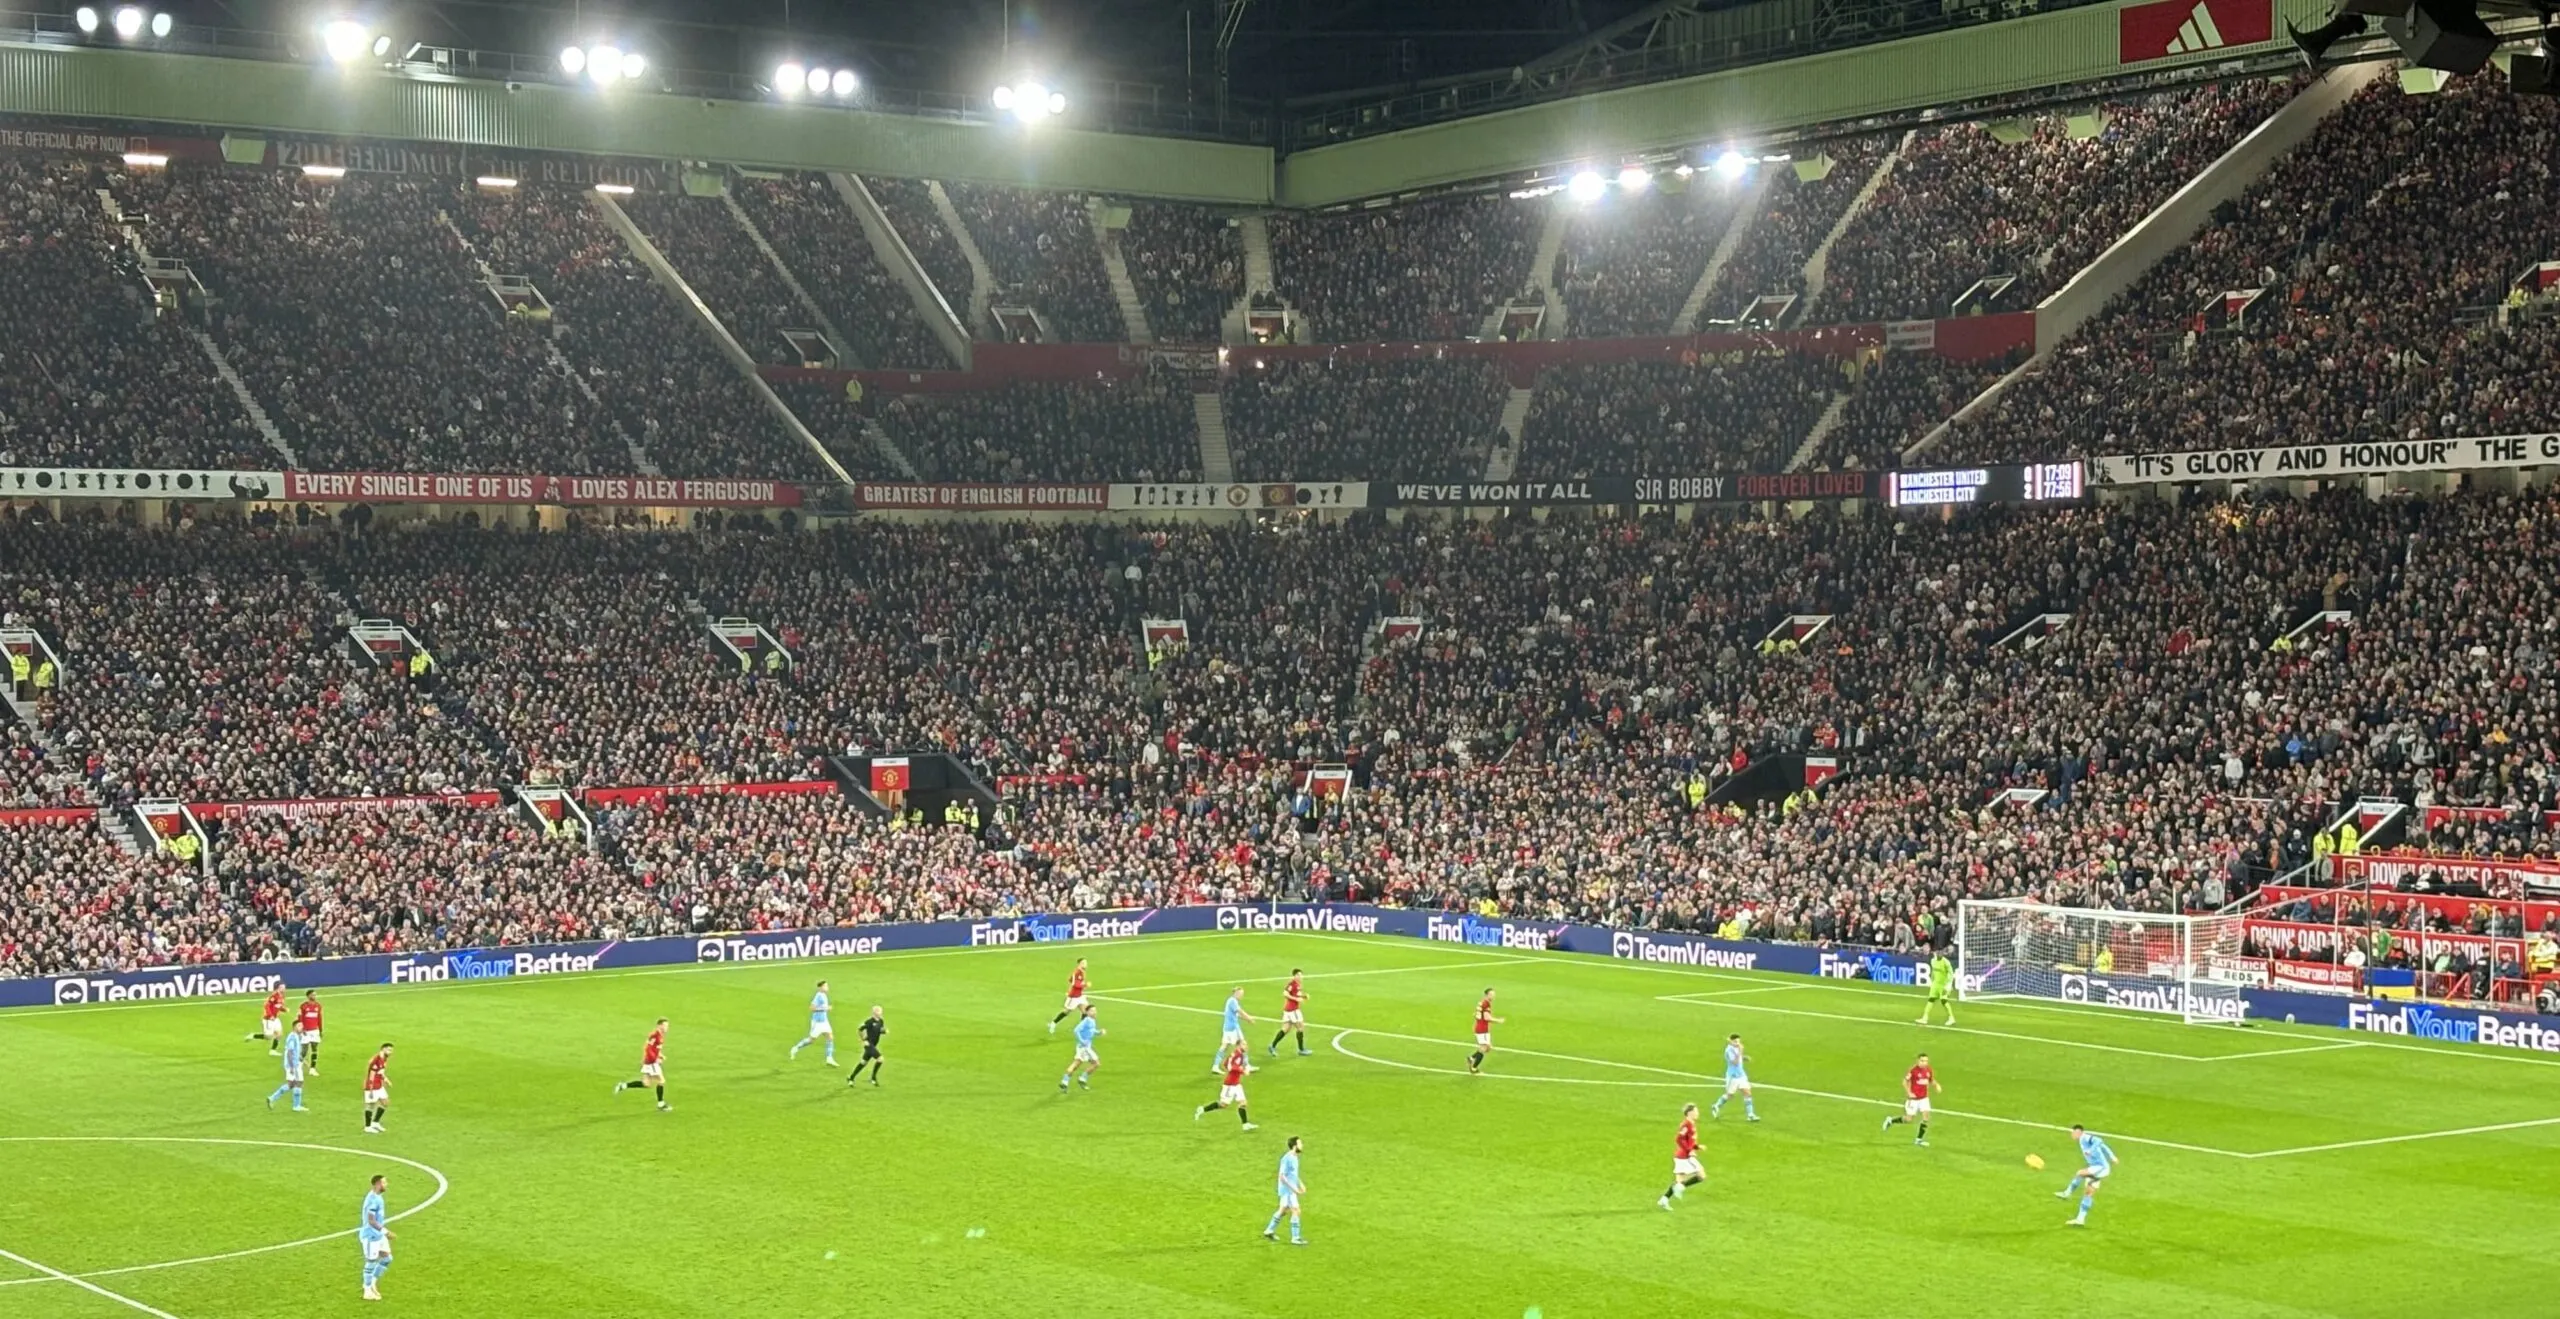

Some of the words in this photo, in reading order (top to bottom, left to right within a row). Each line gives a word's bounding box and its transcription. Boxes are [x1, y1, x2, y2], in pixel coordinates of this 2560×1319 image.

[24, 131, 74, 150] OFFICIAL
[75, 134, 98, 151] APP
[99, 135, 126, 152] NOW
[541, 159, 657, 189] RELIGION
[2186, 451, 2265, 474] GLORY
[2276, 448, 2328, 470] AND
[2340, 441, 2458, 467] HONOUR"
[2475, 438, 2527, 461] THE
[1955, 470, 1988, 485] UNITED
[2044, 464, 2072, 481] 17:09
[295, 474, 356, 495] EVERY
[361, 474, 429, 496] SINGLE
[435, 476, 473, 497] ONE
[478, 477, 502, 498] OF
[507, 477, 532, 498] US
[572, 479, 628, 499] LOVES
[634, 480, 678, 500] ALEX
[684, 480, 774, 501] FERGUSON
[863, 486, 936, 503] GREATEST
[941, 487, 957, 504] OF
[962, 487, 1023, 504] ENGLISH
[1028, 486, 1103, 504] FOOTBALL
[1397, 484, 1462, 500] WE'VE
[1469, 484, 1520, 500] WON
[1526, 483, 1547, 499] IT
[1550, 483, 1592, 499] ALL
[1635, 477, 1662, 500] SIR
[1669, 476, 1725, 499] BOBBY
[1737, 474, 1809, 497] FOREVER
[1814, 473, 1865, 495] LOVED
[1955, 487, 1976, 502] CITY
[2024, 483, 2033, 500] 2
[2044, 481, 2072, 498] 77:56
[972, 920, 1019, 946] Find
[1073, 917, 1143, 939] Better
[1240, 908, 1379, 933] TeamViewer
[1428, 916, 1462, 943] Find
[1462, 918, 1503, 946] Your
[727, 934, 882, 961] TeamViewer
[1634, 936, 1756, 970] TeamViewer
[391, 956, 449, 984] Find
[450, 955, 514, 980] Your
[515, 951, 599, 976] Better
[1864, 955, 1914, 985] Your
[2224, 971, 2253, 982] REDS
[90, 973, 280, 1003] TeamViewer
[2349, 1002, 2408, 1035] Find
[2408, 1007, 2477, 1042] Your
